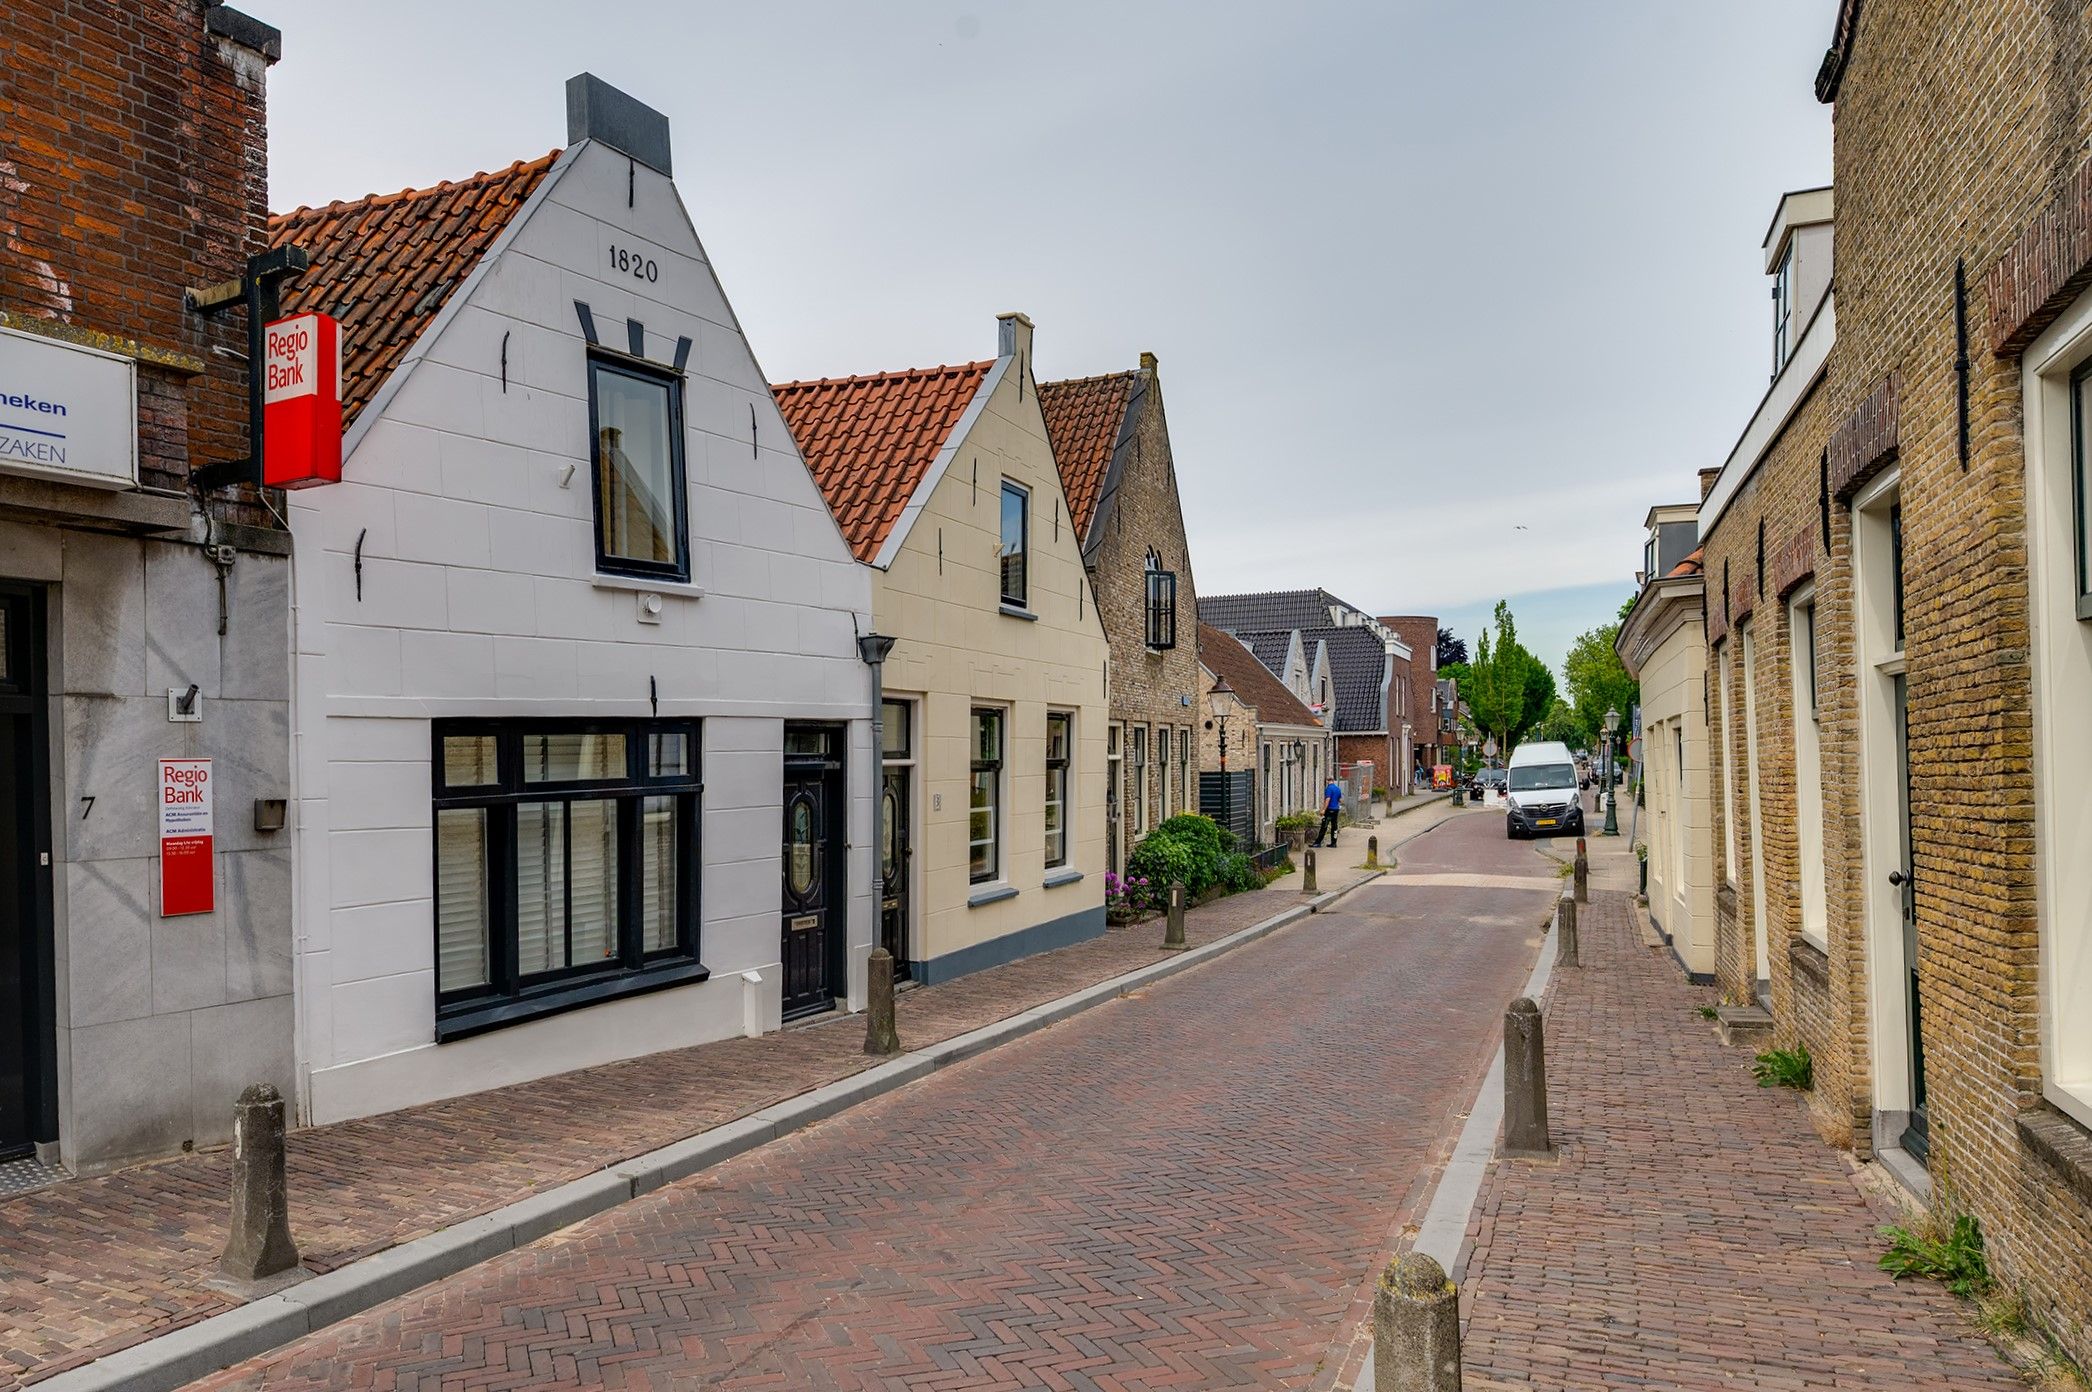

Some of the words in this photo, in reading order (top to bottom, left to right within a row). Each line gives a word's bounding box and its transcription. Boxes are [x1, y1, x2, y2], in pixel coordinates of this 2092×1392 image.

[609, 244, 658, 283] 1820
[269, 324, 308, 361] Regio
[269, 357, 303, 391] Bank
[164, 765, 208, 787] Regio
[80, 796, 96, 820] 7
[165, 785, 204, 804] Bank
